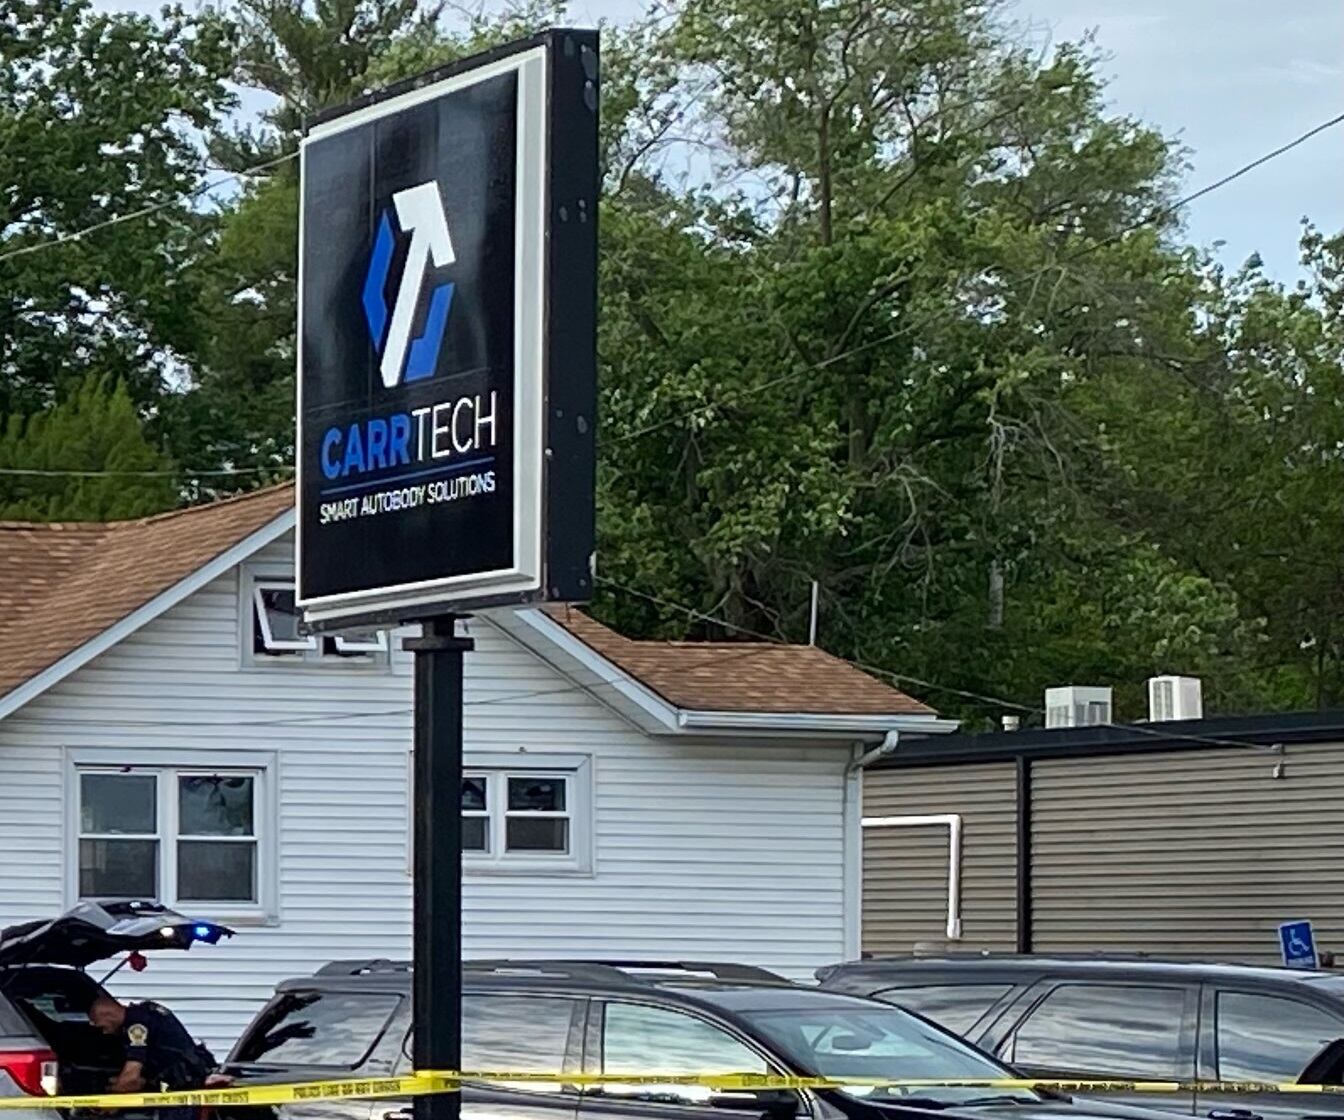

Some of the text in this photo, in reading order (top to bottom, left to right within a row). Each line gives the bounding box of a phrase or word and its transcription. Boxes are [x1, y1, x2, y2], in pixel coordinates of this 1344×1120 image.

[321, 390, 497, 480] CARRTECH
[319, 470, 496, 525] SMART AUTOBODY SOLUTIONS
